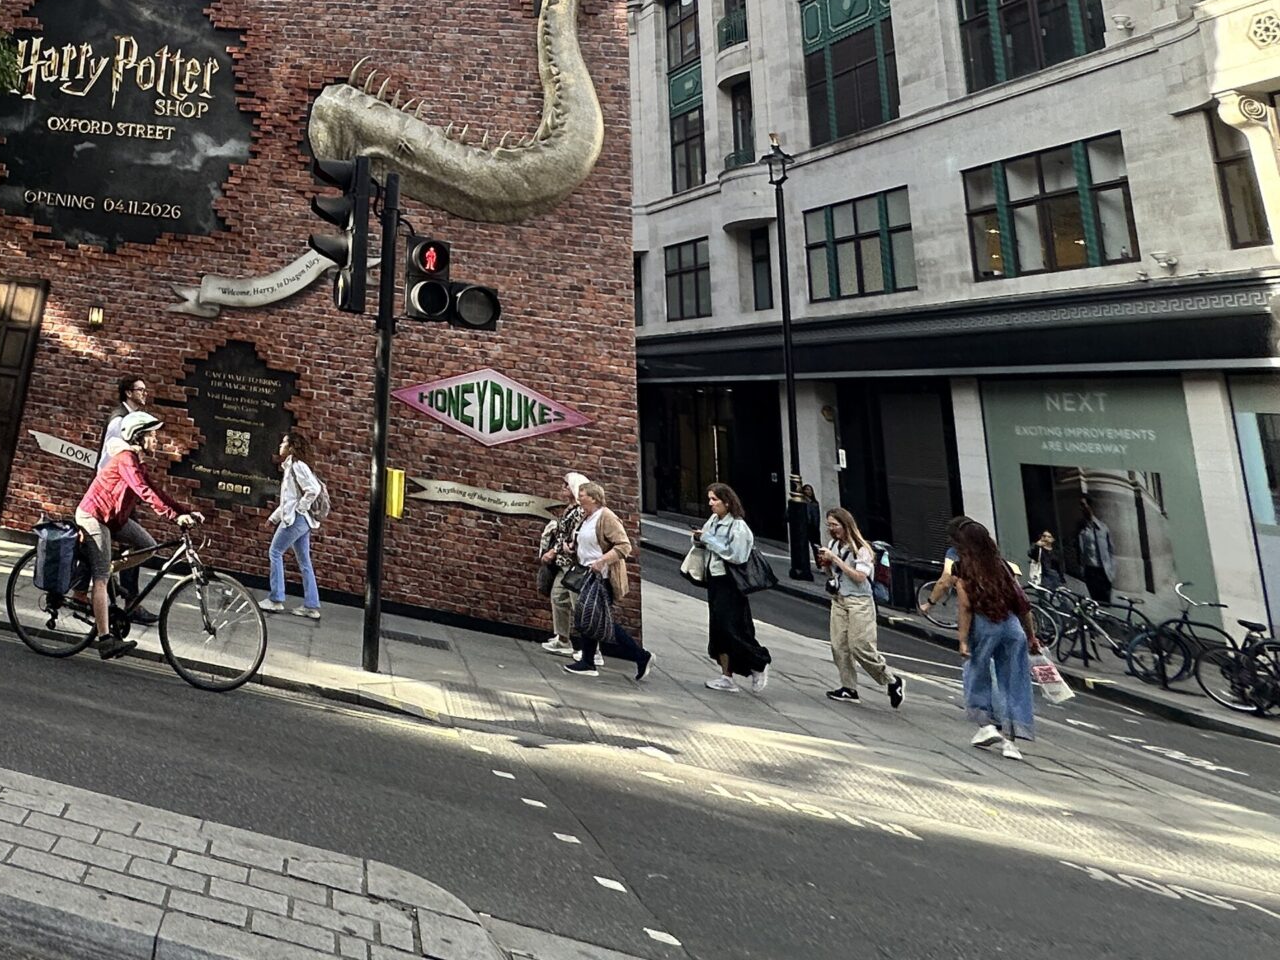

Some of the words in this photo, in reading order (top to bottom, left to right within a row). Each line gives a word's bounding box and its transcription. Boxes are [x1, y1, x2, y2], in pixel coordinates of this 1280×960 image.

[10, 36, 110, 101] Harry
[112, 35, 220, 109] Potter
[154, 98, 209, 119] SHOP
[47, 116, 113, 136] OXFORD
[115, 121, 176, 141] STREET
[24, 189, 95, 210] OPENING
[103, 197, 182, 220] 04.11.2026
[417, 379, 566, 435] HONEYDUKES
[1044, 392, 1108, 413] NEXT
[1014, 425, 1063, 438] EXCITING
[1063, 426, 1157, 442] IMPROVEMENTS
[60, 444, 92, 464] LOOK
[1041, 441, 1063, 452] ARE
[1064, 442, 1128, 455] UNDERWAY
